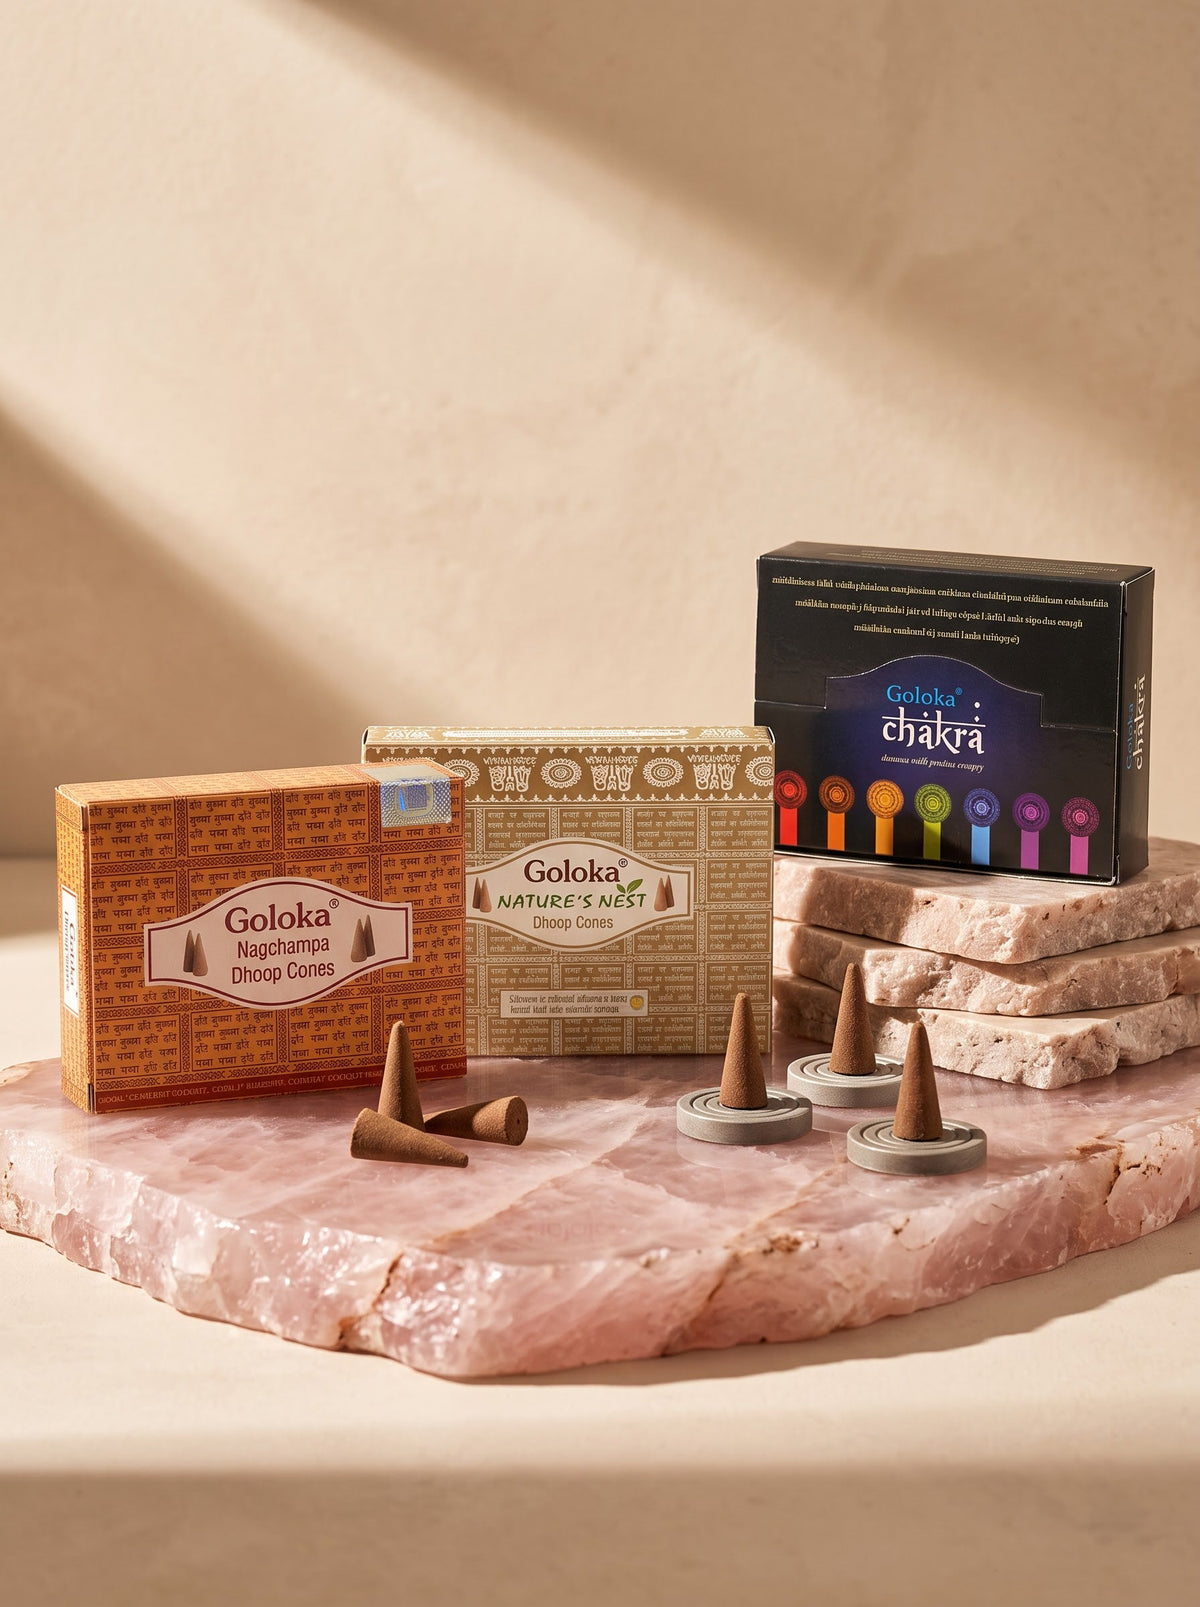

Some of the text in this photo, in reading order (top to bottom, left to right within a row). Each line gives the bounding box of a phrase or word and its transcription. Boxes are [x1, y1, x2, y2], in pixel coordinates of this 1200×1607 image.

[497, 893, 647, 909] NATURE'S NEST
[533, 915, 614, 931] Dhoop Cones
[237, 937, 330, 961] Nagchampa
[231, 961, 335, 985] Dhoop Cones
